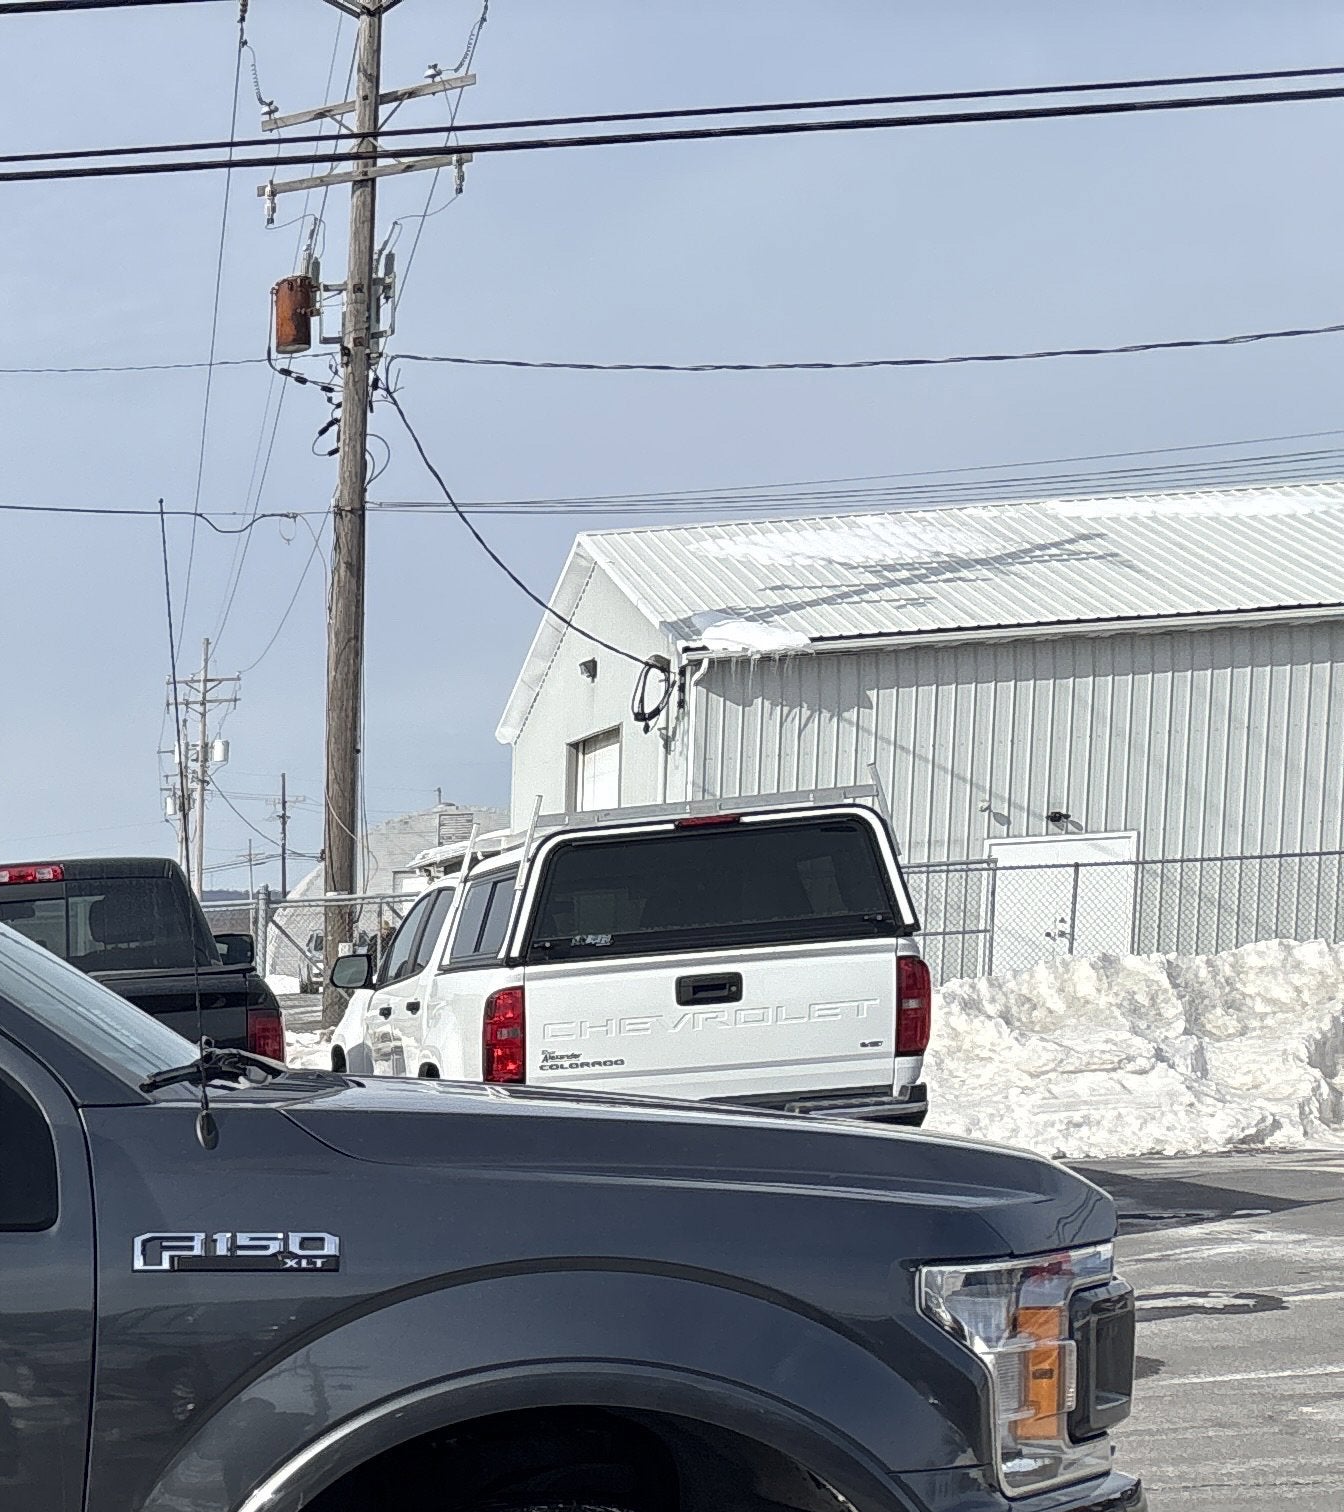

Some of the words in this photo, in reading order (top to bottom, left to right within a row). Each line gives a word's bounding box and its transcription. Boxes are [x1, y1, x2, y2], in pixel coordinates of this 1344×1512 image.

[543, 998, 880, 1041] CHEVROLET
[539, 1059, 625, 1071] COLORADO
[282, 1258, 328, 1268] XLT
